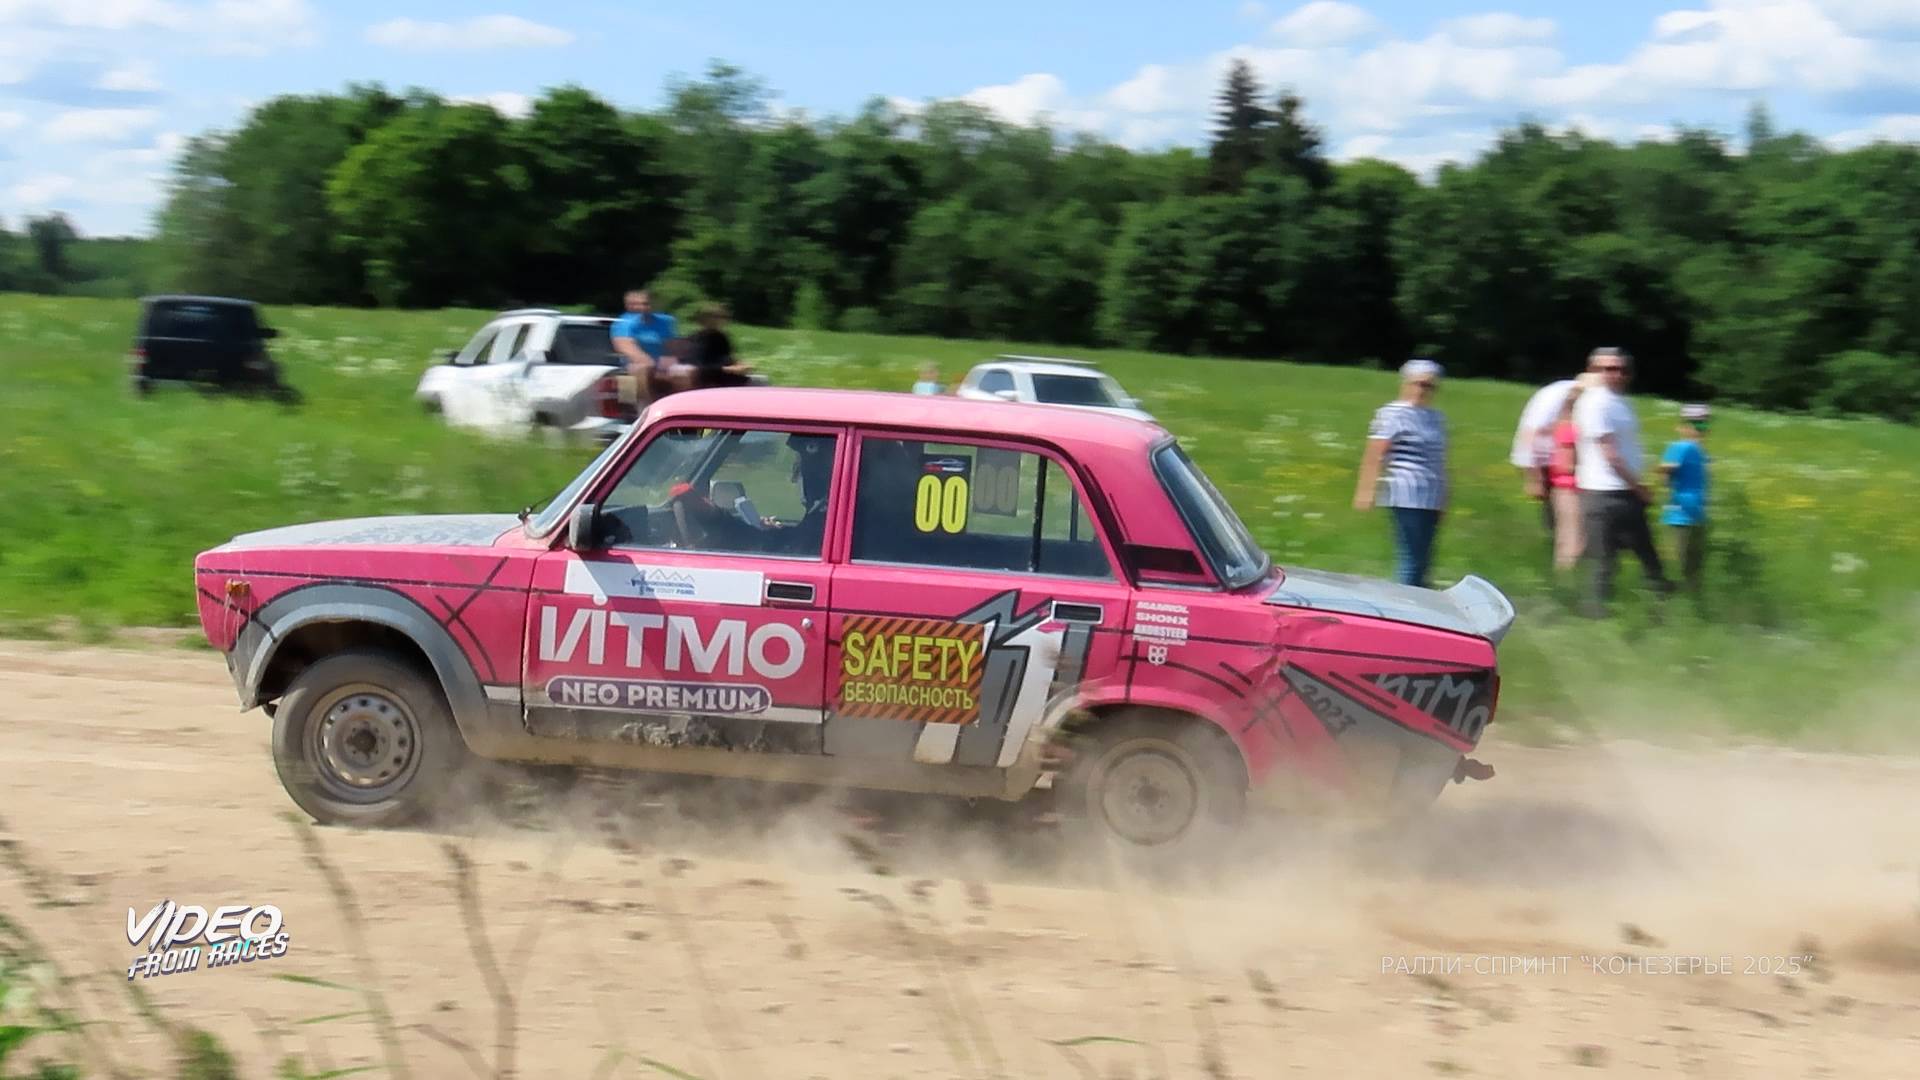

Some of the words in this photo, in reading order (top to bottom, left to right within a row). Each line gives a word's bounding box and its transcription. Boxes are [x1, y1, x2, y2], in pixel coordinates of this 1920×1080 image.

[915, 474, 968, 534] 00
[1136, 611, 1189, 626] SHONX
[845, 631, 979, 683] SAFETY
[561, 681, 620, 706] NEO
[627, 684, 762, 711] PREMIUM
[844, 682, 974, 711] БЕЗОПАСНОСТЬ
